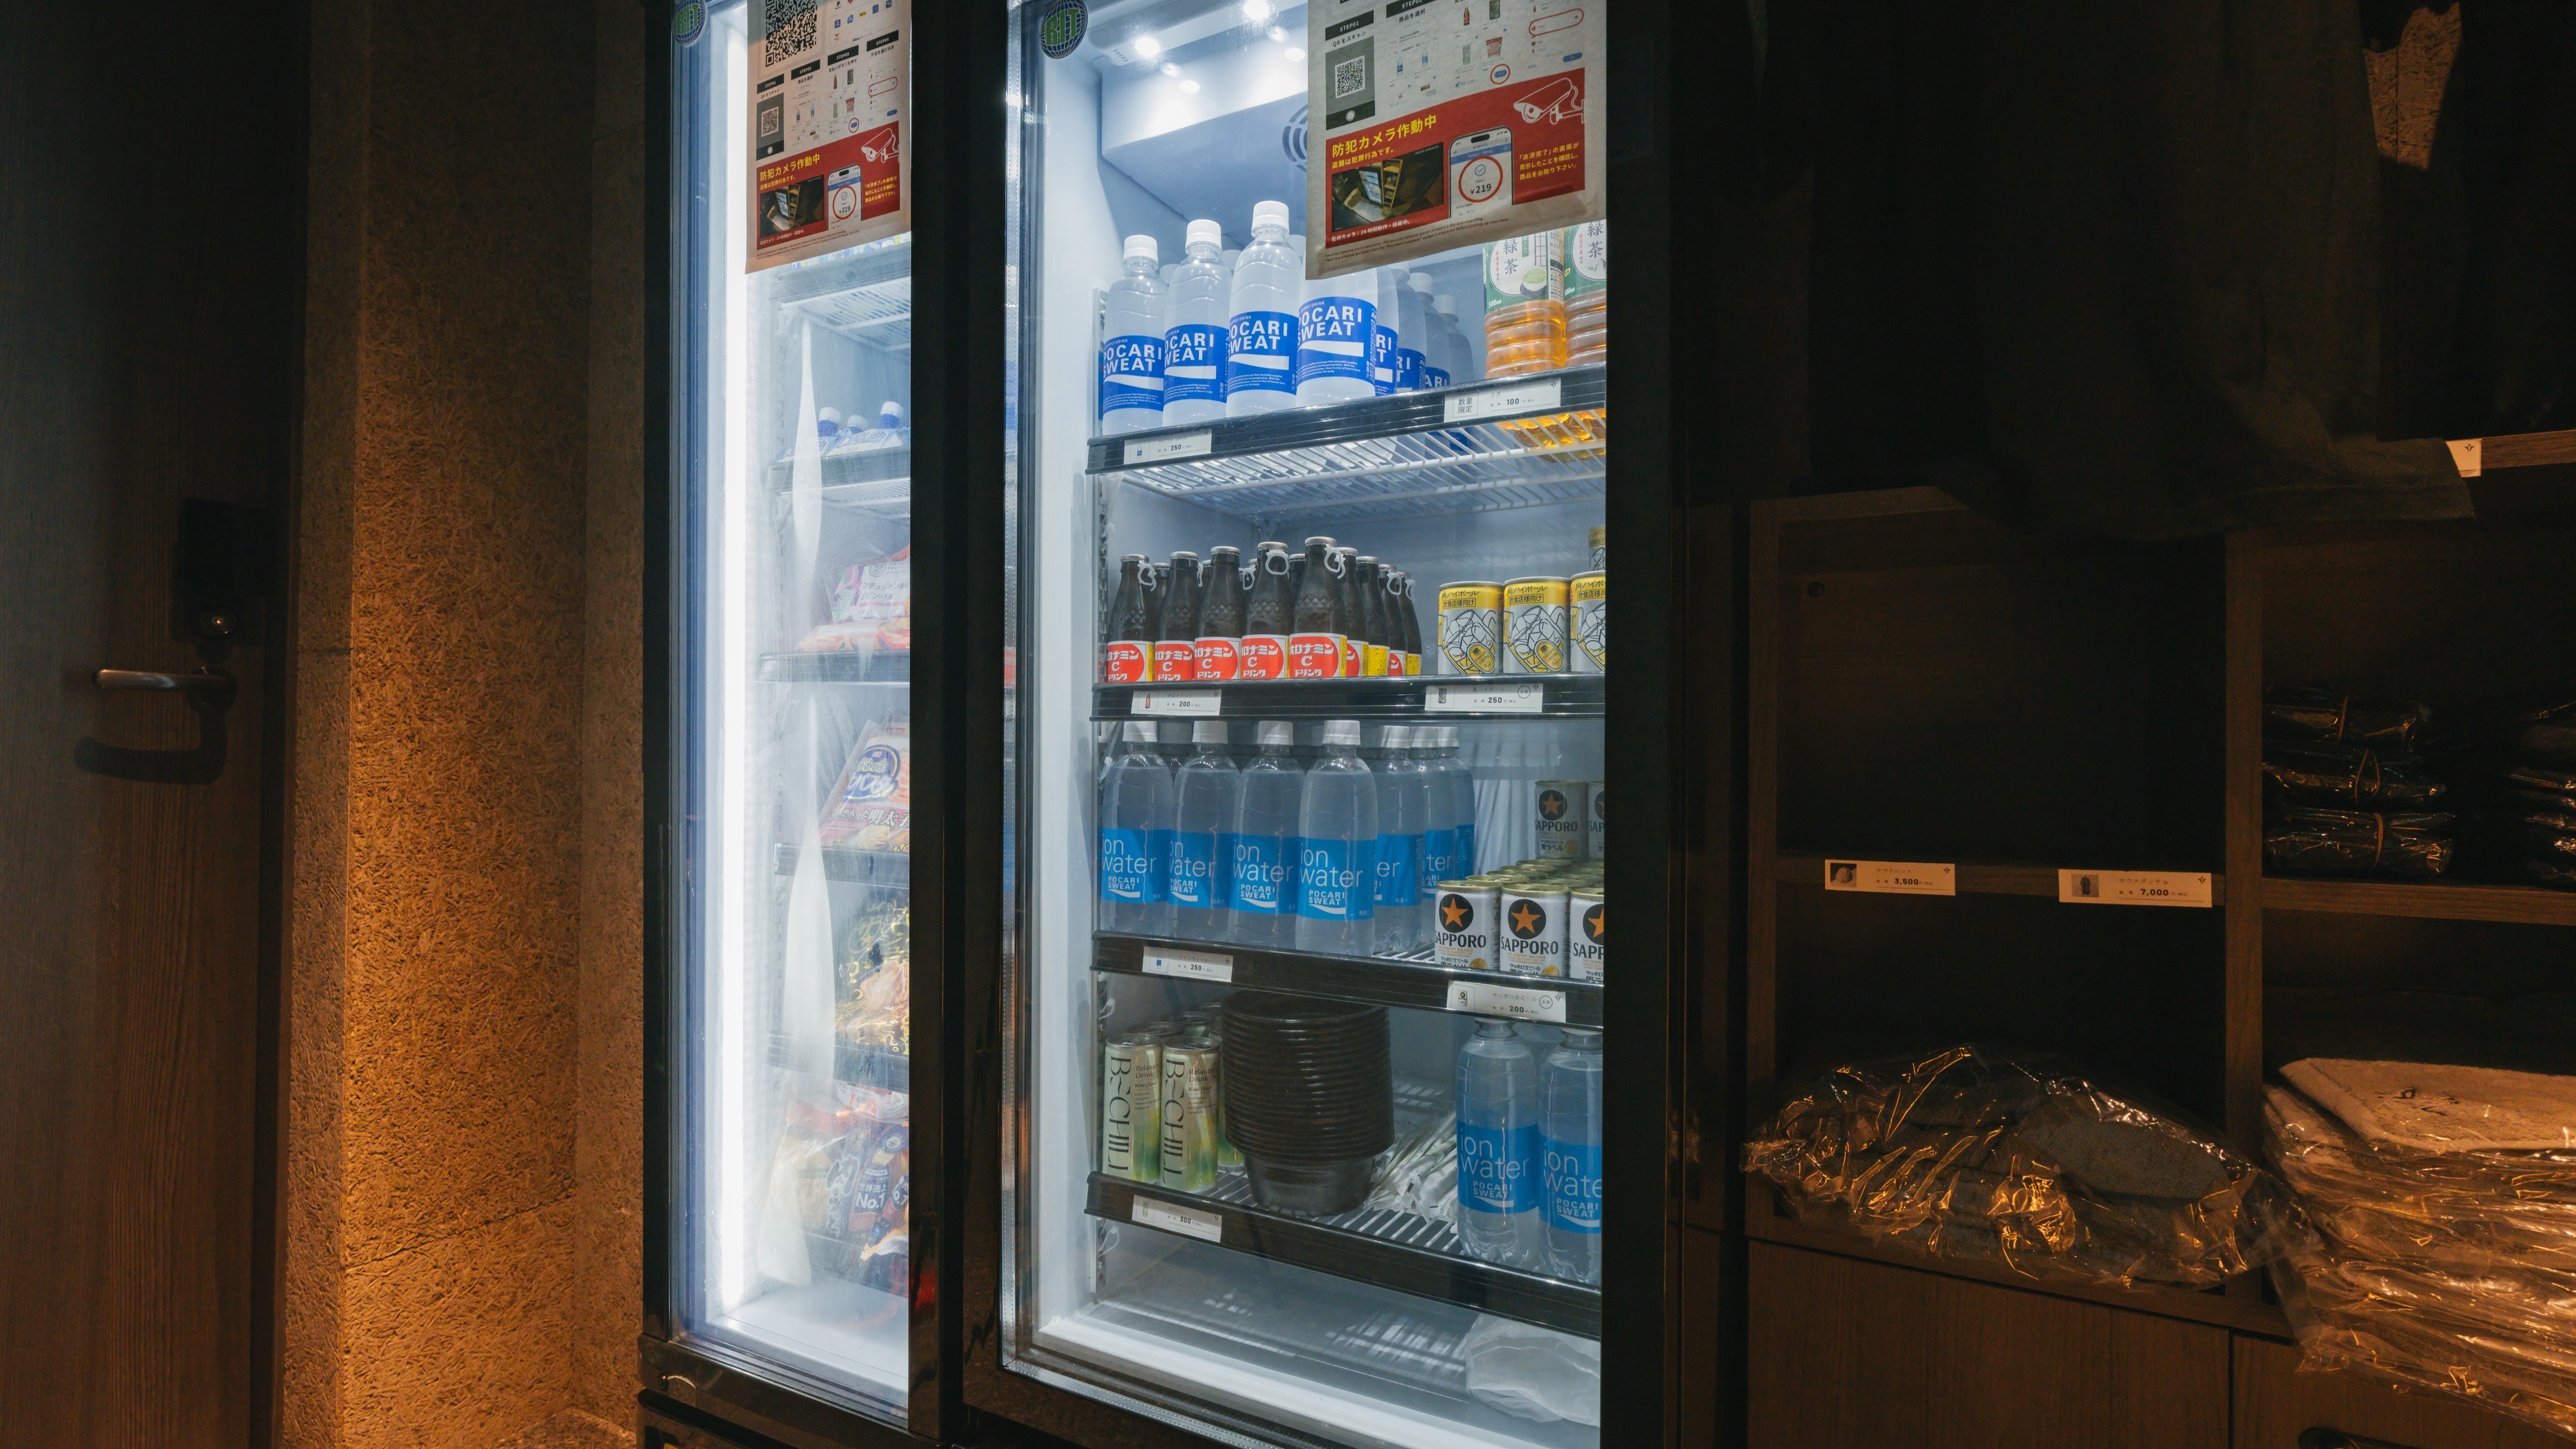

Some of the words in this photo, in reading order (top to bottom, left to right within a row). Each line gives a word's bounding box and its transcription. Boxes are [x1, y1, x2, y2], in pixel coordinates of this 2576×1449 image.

[677, 4, 700, 34] RIT
[1398, 9, 1425, 23] 商品を選択
[1046, 8, 1078, 46] RIT
[1340, 21, 1359, 32] STEP01
[876, 37, 890, 45] STEP04
[837, 52, 850, 60] STEP03
[800, 66, 812, 74] STEP02
[765, 80, 776, 88] STEP01
[1332, 114, 1437, 158] 防犯カメラ作動中
[1519, 142, 1579, 160] 「決済完了」の画面が
[1332, 147, 1394, 169] 盗難は犯罪行為です。
[1519, 153, 1578, 170] 表示したことを確認し、
[760, 153, 820, 181] 防犯カメラ作動中
[1519, 163, 1577, 180] 商品をお取り下さい。
[1470, 183, 1492, 195] ¥219
[1587, 220, 1603, 258] 緑茶
[1503, 238, 1518, 275] 緑茶
[1488, 299, 1502, 309] 500ml
[1229, 320, 1287, 339] OCARI
[1165, 333, 1214, 354] OCARI
[1228, 335, 1281, 355] WEAT
[1165, 347, 1207, 369] WEAT
[1459, 397, 1472, 405] 数量
[1458, 405, 1472, 414] 限定
[1442, 590, 1479, 600] 角ハイボール
[1507, 586, 1547, 595] 角ハイボール
[1578, 590, 1605, 601] 飲食店様向
[1444, 599, 1475, 608] 飲食店様向け
[1510, 595, 1542, 604] 飲食店様向け
[1290, 643, 1334, 655] オロナミン
[1112, 662, 1120, 672] C
[1163, 662, 1172, 672] C
[1202, 658, 1212, 669] C
[1248, 657, 1258, 668] C
[1301, 656, 1313, 666] C
[1295, 669, 1322, 677] ドリンク
[868, 809, 909, 827] 明太子
[1535, 820, 1578, 831] SAPPORO
[1170, 841, 1183, 858] on
[1234, 838, 1260, 862] ion
[1301, 843, 1328, 867] ion
[1102, 856, 1157, 874] water
[1234, 860, 1294, 883] water
[1300, 867, 1364, 888] water
[1171, 878, 1198, 887] POCARI
[1240, 883, 1275, 893] POCARI
[1170, 885, 1194, 894] SWEAT
[1240, 890, 1270, 899] SWEAT
[1309, 890, 1345, 899] POCARI
[1309, 896, 1342, 906] SWEAT
[1435, 930, 1487, 948] SAPPORO
[1501, 937, 1559, 954] SAPPORO
[1574, 942, 1603, 960] SAPP
[1493, 993, 1538, 1001] サッポロ生ビール
[1461, 1129, 1493, 1158] ion
[1544, 1143, 1578, 1176] ion
[1461, 1156, 1529, 1180] water
[859, 1182, 887, 1193] 世界売上
[1473, 1180, 1512, 1191] POCARI
[1473, 1188, 1508, 1198] SWEAT
[856, 1192, 885, 1209] No.1
[1556, 1197, 1598, 1210] POCARI
[1168, 1206, 1186, 1214] BECHILL
[1556, 1206, 1594, 1218] SWEAT
